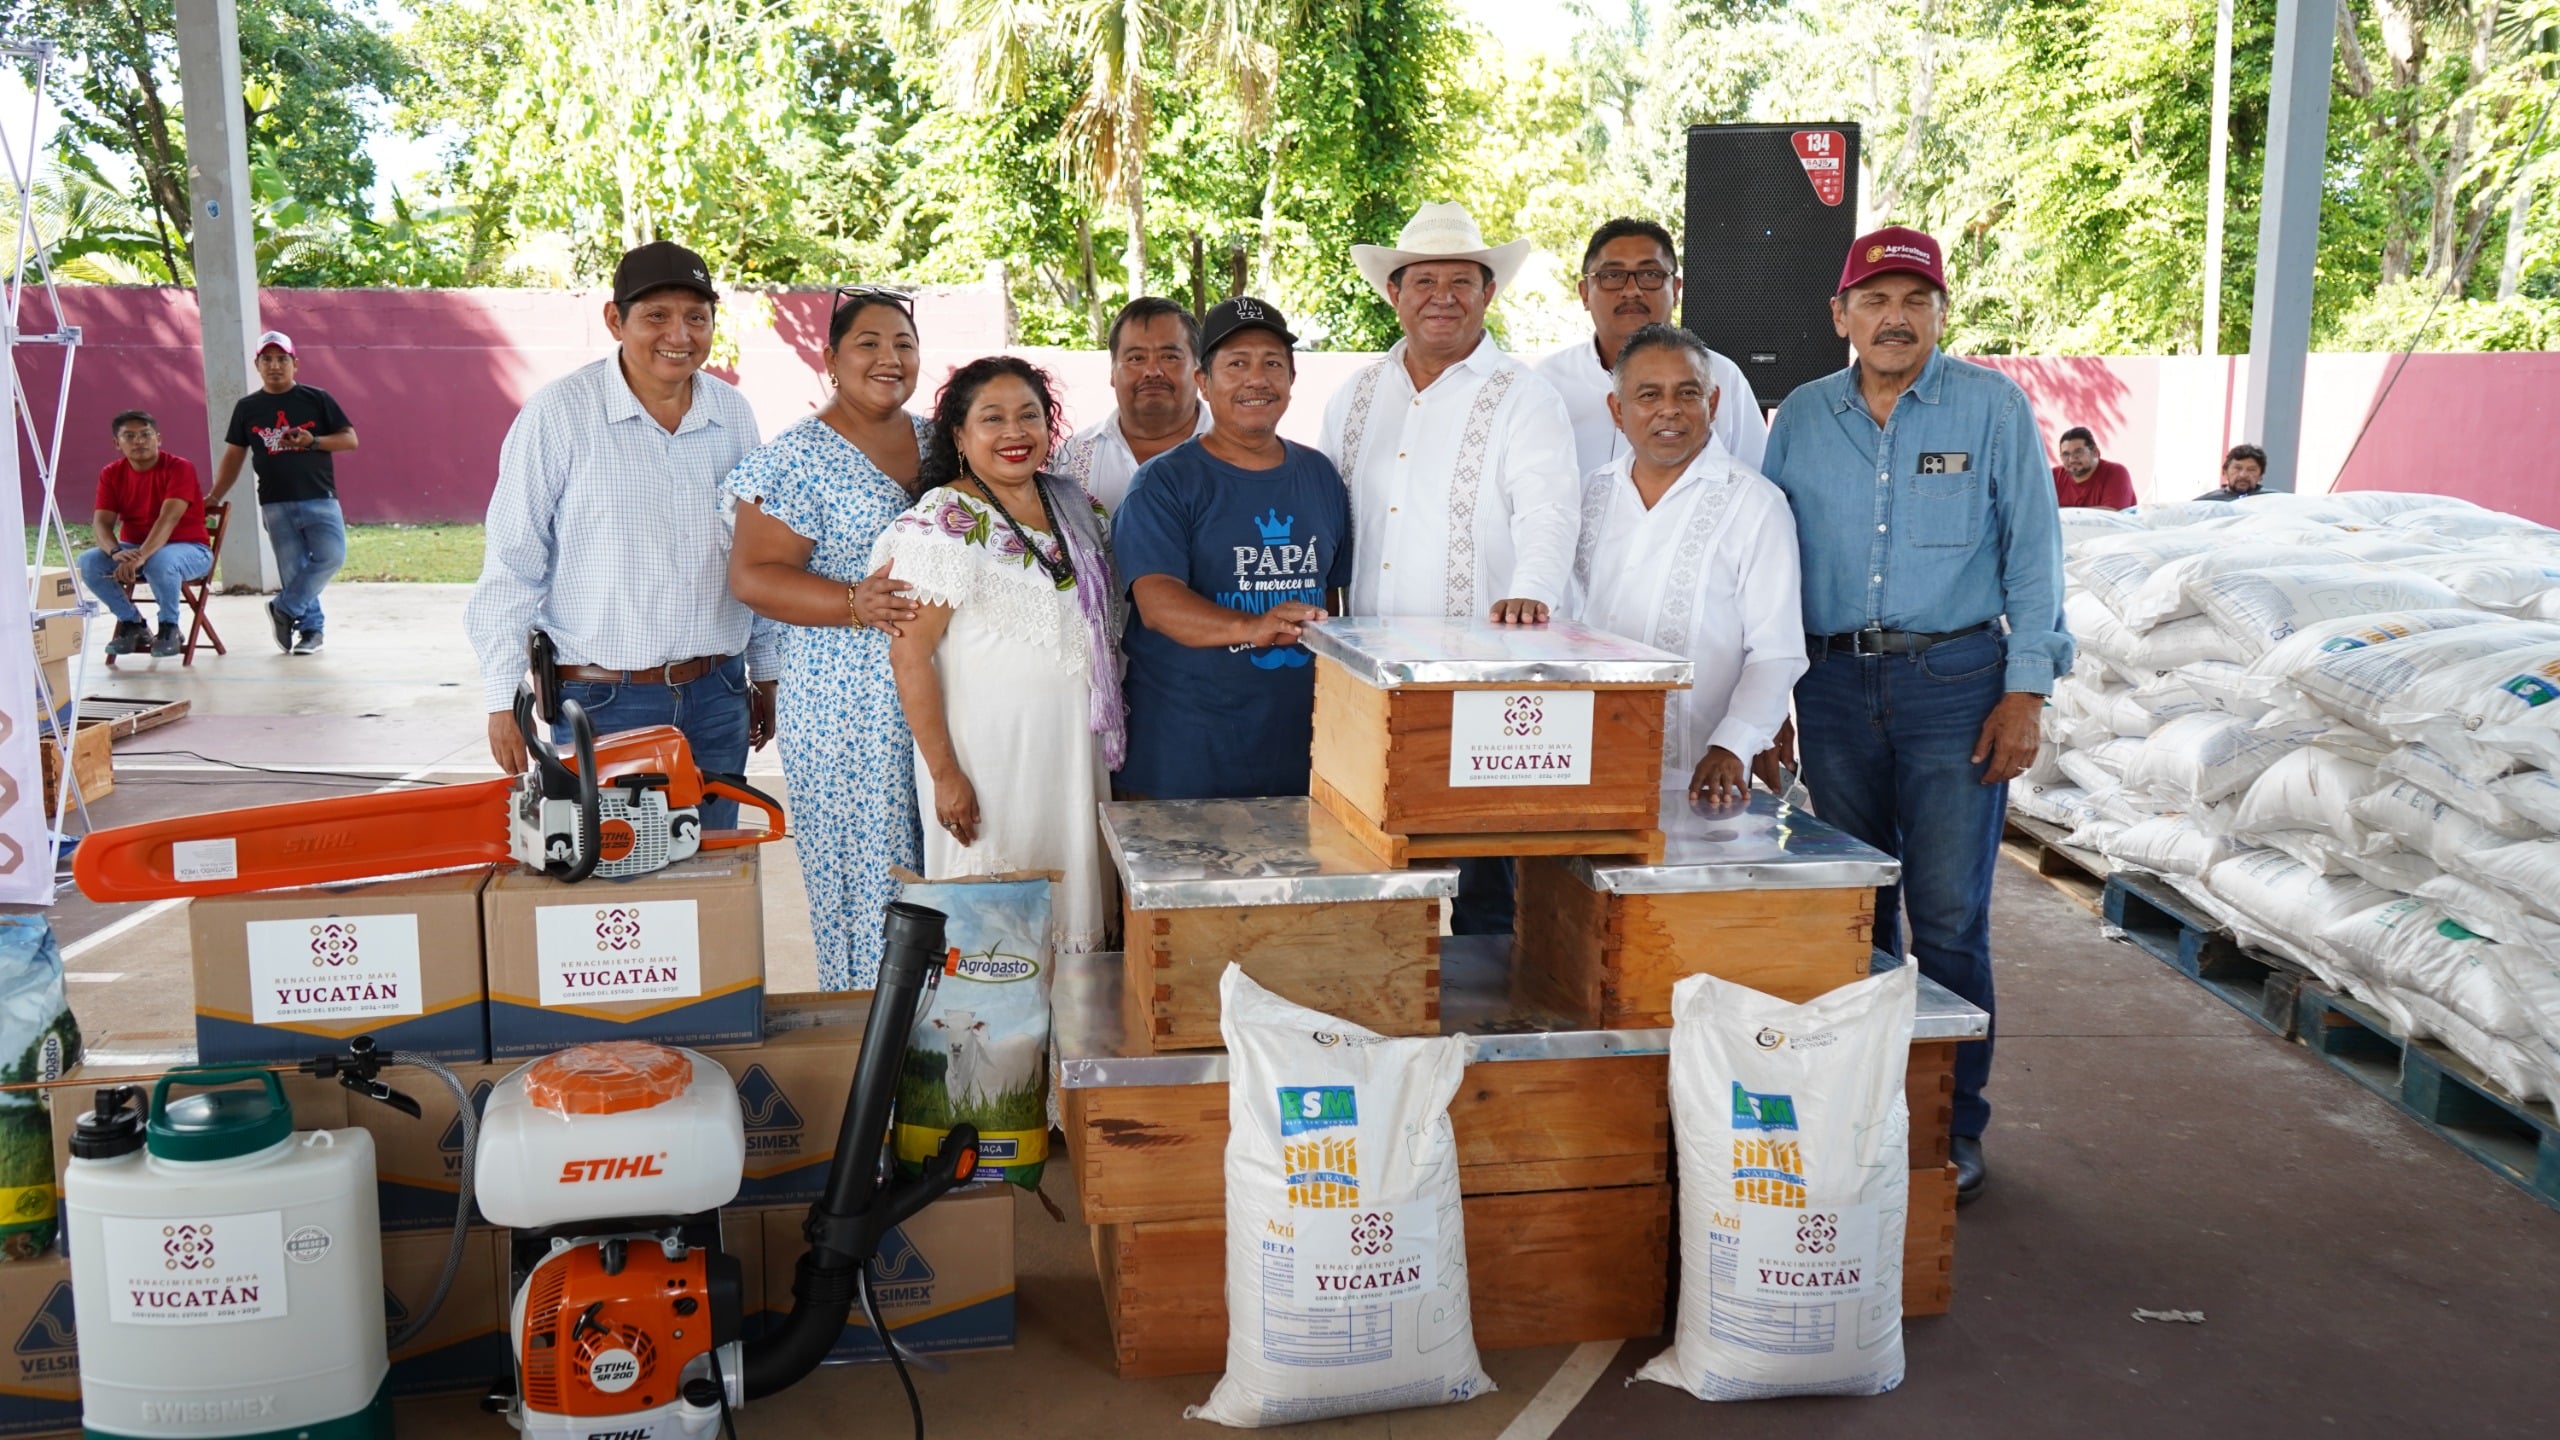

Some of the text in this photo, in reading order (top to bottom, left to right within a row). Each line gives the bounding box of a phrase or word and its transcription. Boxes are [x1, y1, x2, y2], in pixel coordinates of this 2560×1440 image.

[1806, 133, 1830, 152] 134
[1885, 245, 1930, 260] Agricultura
[1233, 297, 1264, 320] LA
[1233, 535, 1319, 576] PAPÁ
[1238, 576, 1316, 591] te mereces un
[1471, 752, 1572, 770] YUCATÁN
[284, 832, 356, 853] STIHL
[561, 955, 678, 969] RENACIMIENTO MAYA
[958, 958, 1029, 976] Agropasto
[274, 973, 363, 985] RENACIMIENTO
[562, 965, 678, 988] YUCATÁN
[276, 983, 397, 1005] YUCATÁN
[41, 1038, 58, 1101] Aopasto
[1281, 1089, 1353, 1119] BSM
[747, 1135, 801, 1149] SIMEX
[559, 1154, 664, 1183] STIHL
[1295, 1173, 1345, 1184] NURAL
[1266, 1218, 1294, 1238] Azú
[1711, 1211, 1741, 1230] Azú
[1263, 1240, 1294, 1254] BETA
[1315, 1254, 1421, 1271] RENACIMIENTO MAYA
[129, 1274, 259, 1286] RENACIMIENTO MAYA
[1316, 1265, 1421, 1291] YUCATÁN
[1758, 1268, 1861, 1287] YUCATÁN
[130, 1286, 259, 1308] YUCATÁN
[879, 1286, 931, 1301] SIMEX
[593, 1361, 636, 1374] STIHL
[596, 1371, 634, 1382] SR 200
[141, 1395, 275, 1424] SWISSMEX
[588, 1428, 652, 1440] STIHL
